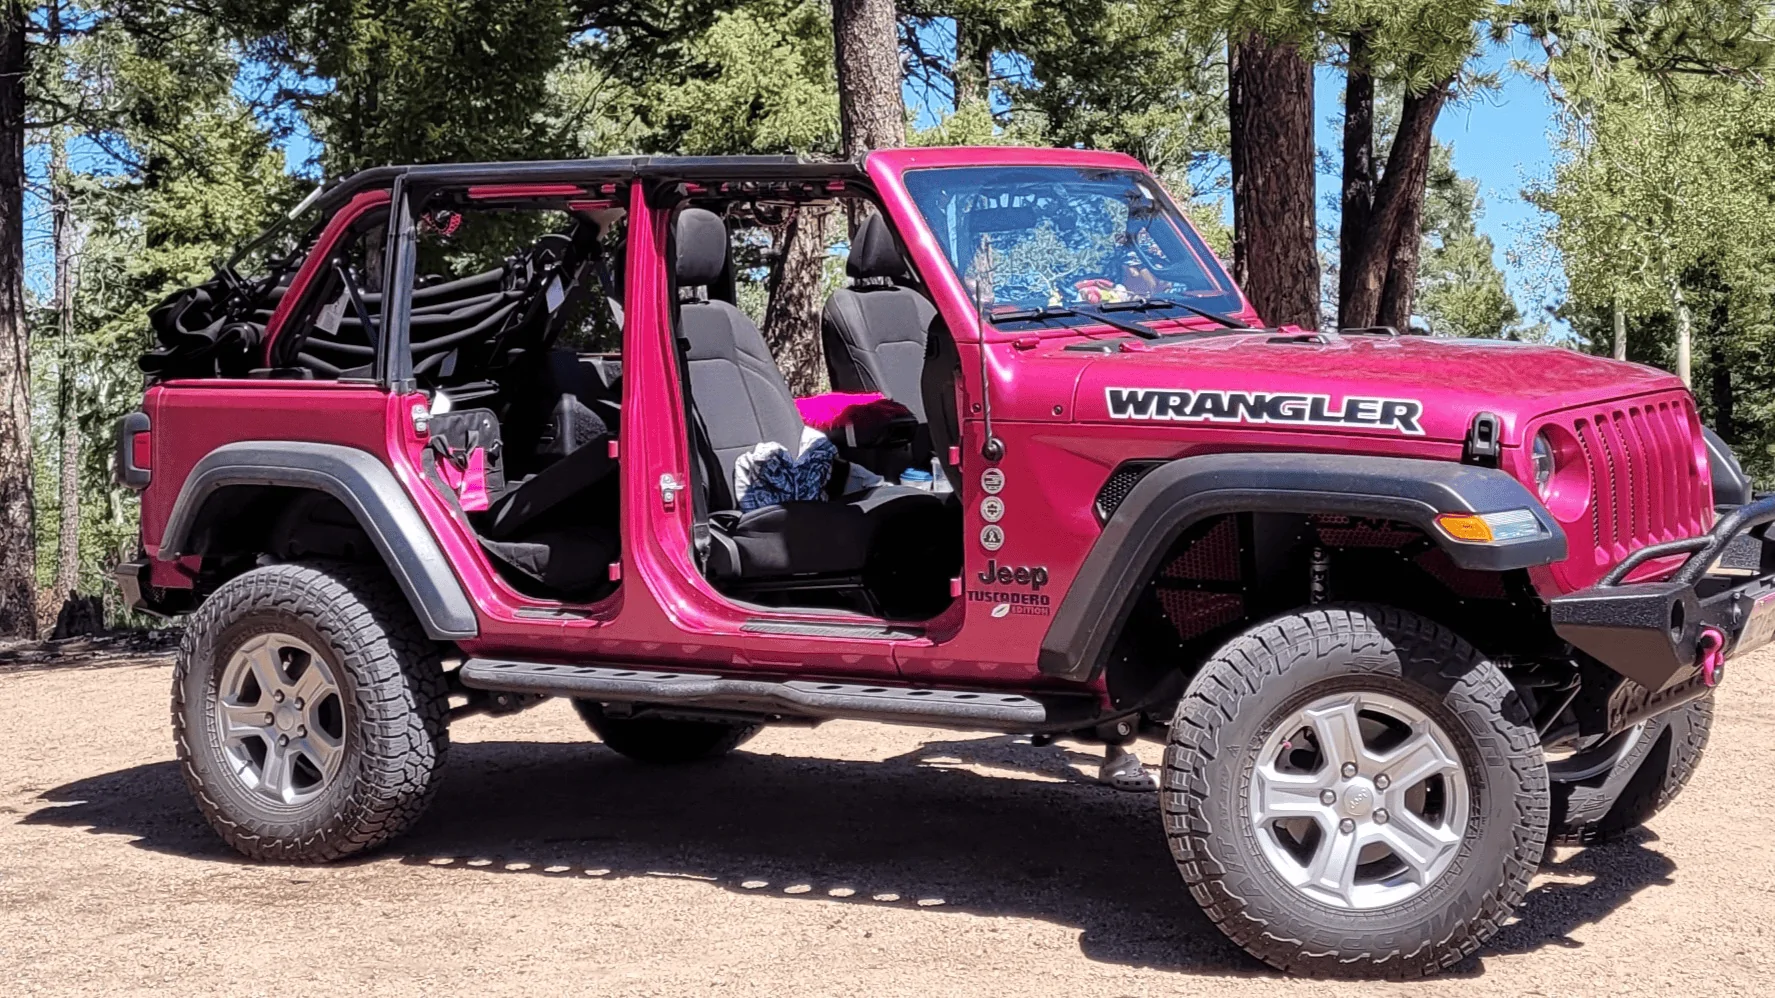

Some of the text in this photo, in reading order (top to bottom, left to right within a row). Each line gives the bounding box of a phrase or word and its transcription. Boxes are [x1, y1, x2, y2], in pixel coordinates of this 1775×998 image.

[1105, 387, 1425, 435] WRANGLER
[978, 559, 1049, 591] Jeep
[967, 591, 1050, 606] TUSCADERO
[1011, 605, 1049, 617] EDITION
[1256, 887, 1474, 951] WILDPEAK
